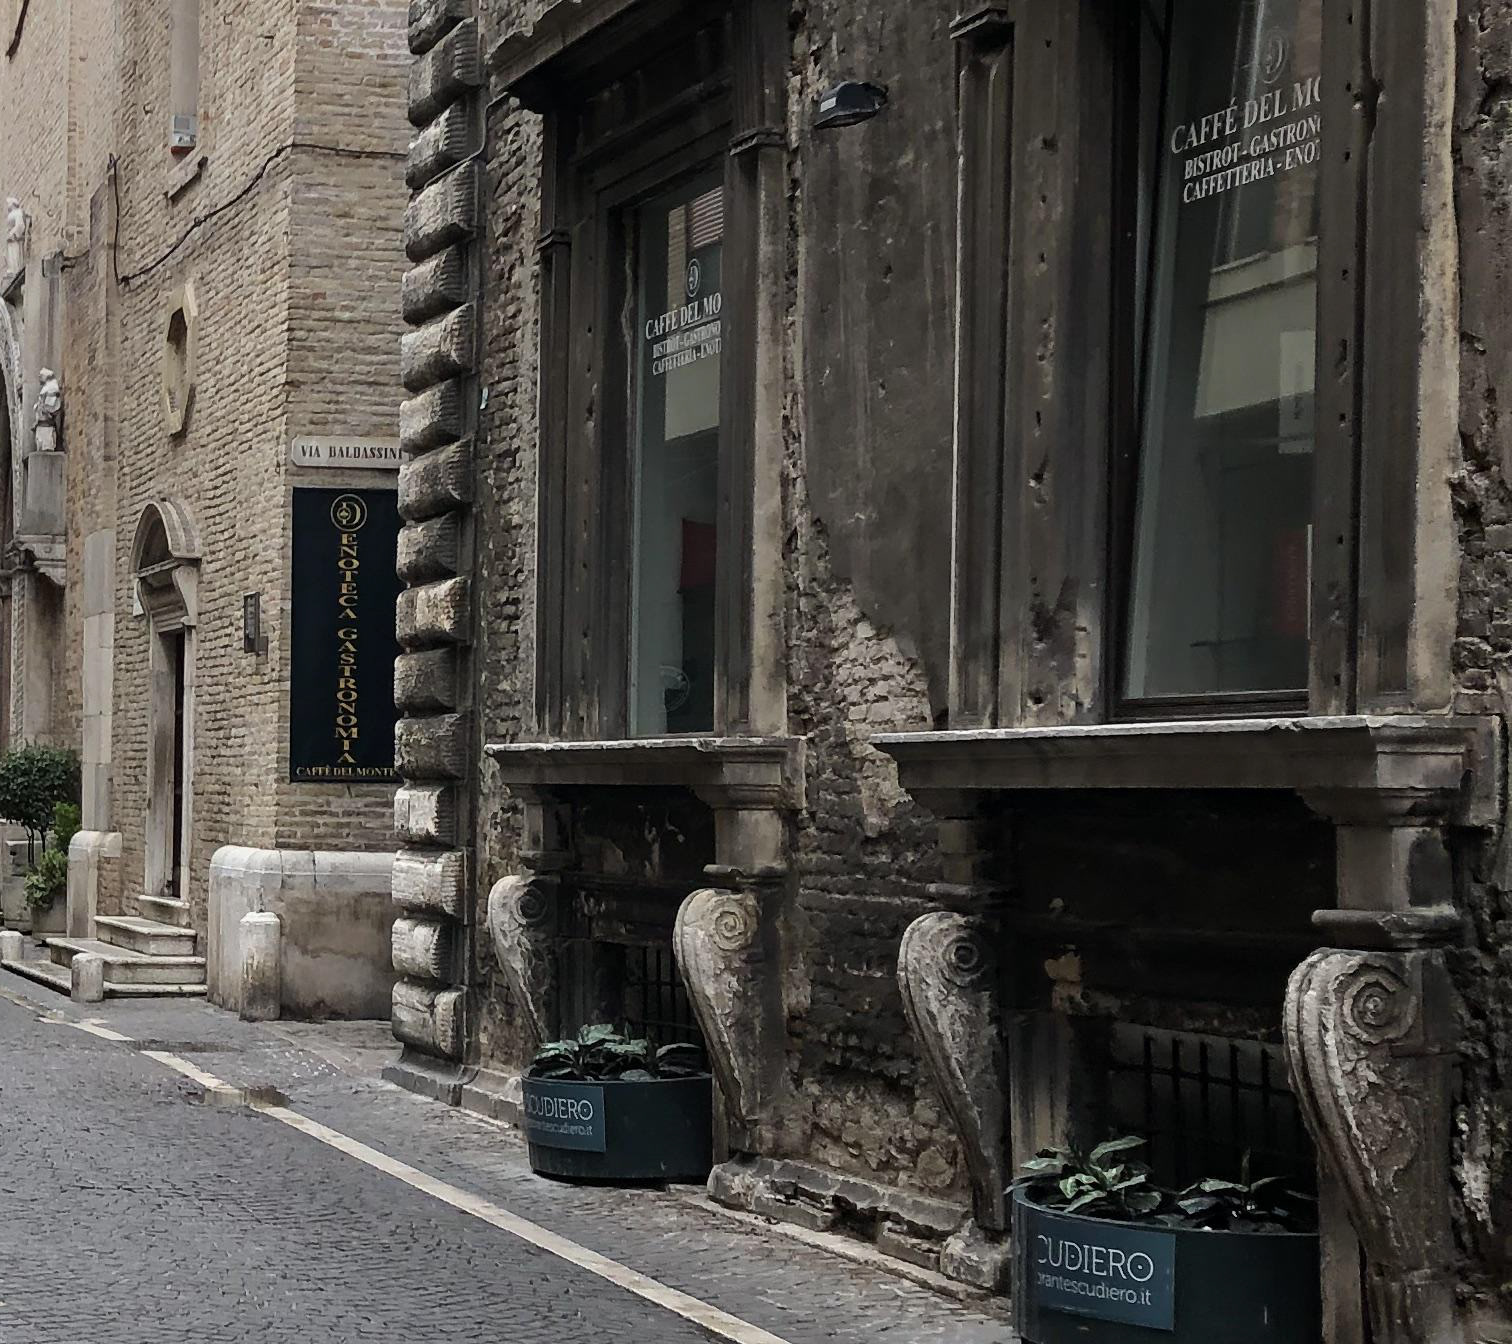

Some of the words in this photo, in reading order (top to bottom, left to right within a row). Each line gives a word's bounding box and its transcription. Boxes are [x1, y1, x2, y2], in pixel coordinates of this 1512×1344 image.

[1243, 89, 1287, 129] DEL
[1184, 142, 1241, 180] BISTROT
[1250, 115, 1321, 157] GASTRON
[1183, 158, 1275, 203] CAFFETTERIA
[680, 300, 702, 327] DEL
[301, 445, 321, 458] VIA
[329, 446, 403, 460] BALDASSINI
[337, 533, 360, 619] ENOTECA
[335, 627, 359, 764] GASTRONOMIA
[333, 766, 354, 776] DEL
[356, 767, 395, 777] MONTE
